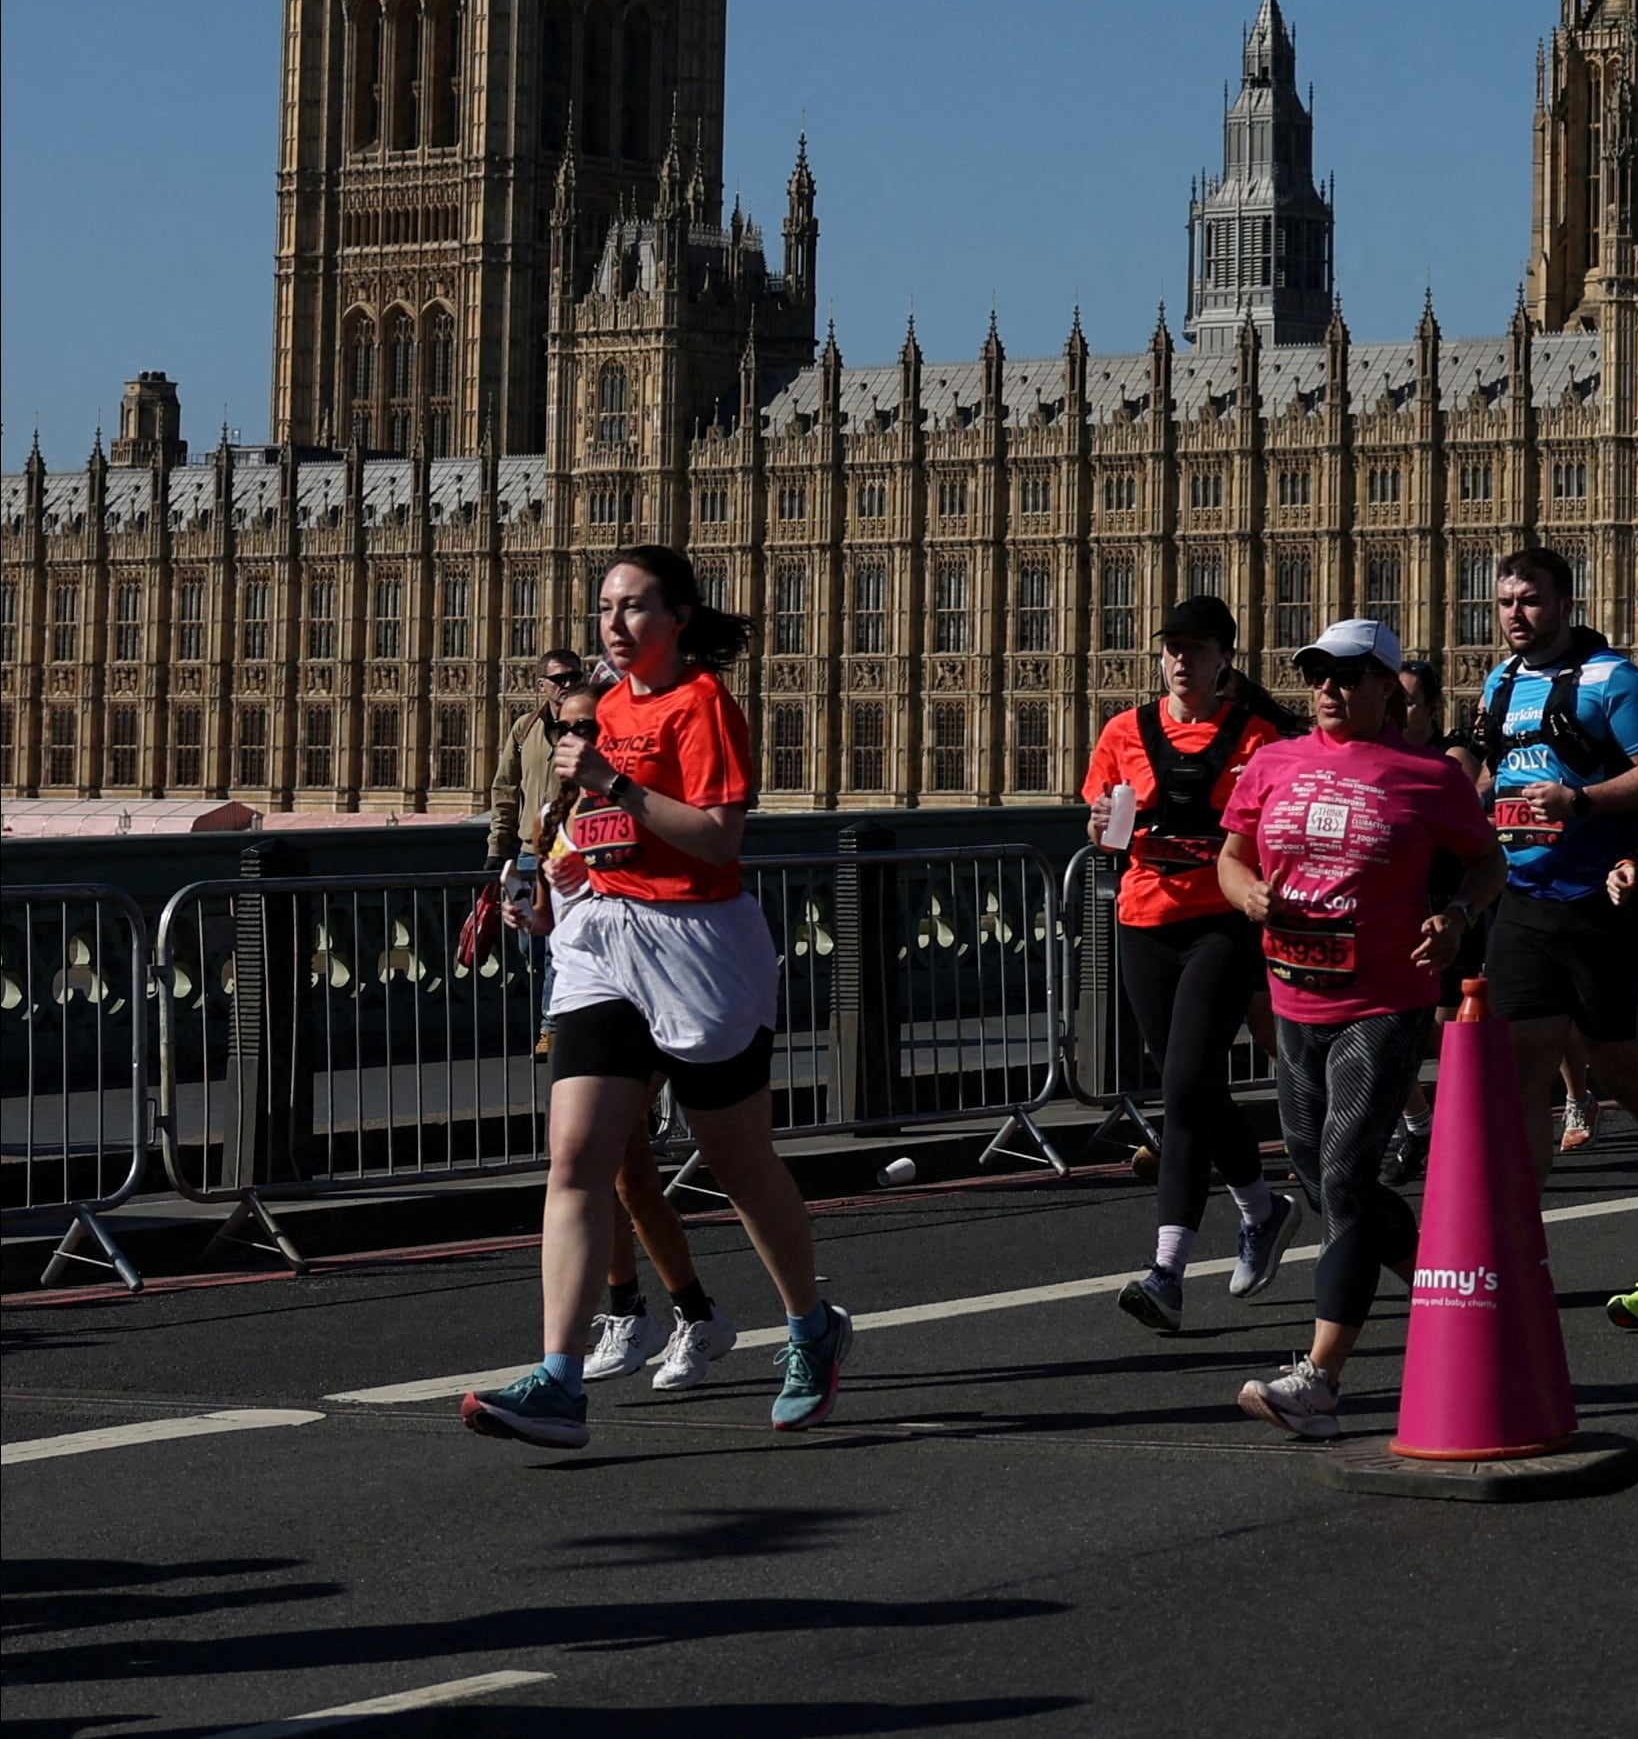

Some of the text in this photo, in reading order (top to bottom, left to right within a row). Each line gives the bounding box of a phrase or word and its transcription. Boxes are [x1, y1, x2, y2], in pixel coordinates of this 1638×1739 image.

[1318, 806, 1345, 817] THINK
[578, 813, 630, 844] 15773
[1283, 883, 1358, 912] Yes I Can
[1430, 1297, 1445, 1305] and
[1445, 1297, 1467, 1309] baby
[1468, 1299, 1497, 1310] charity
